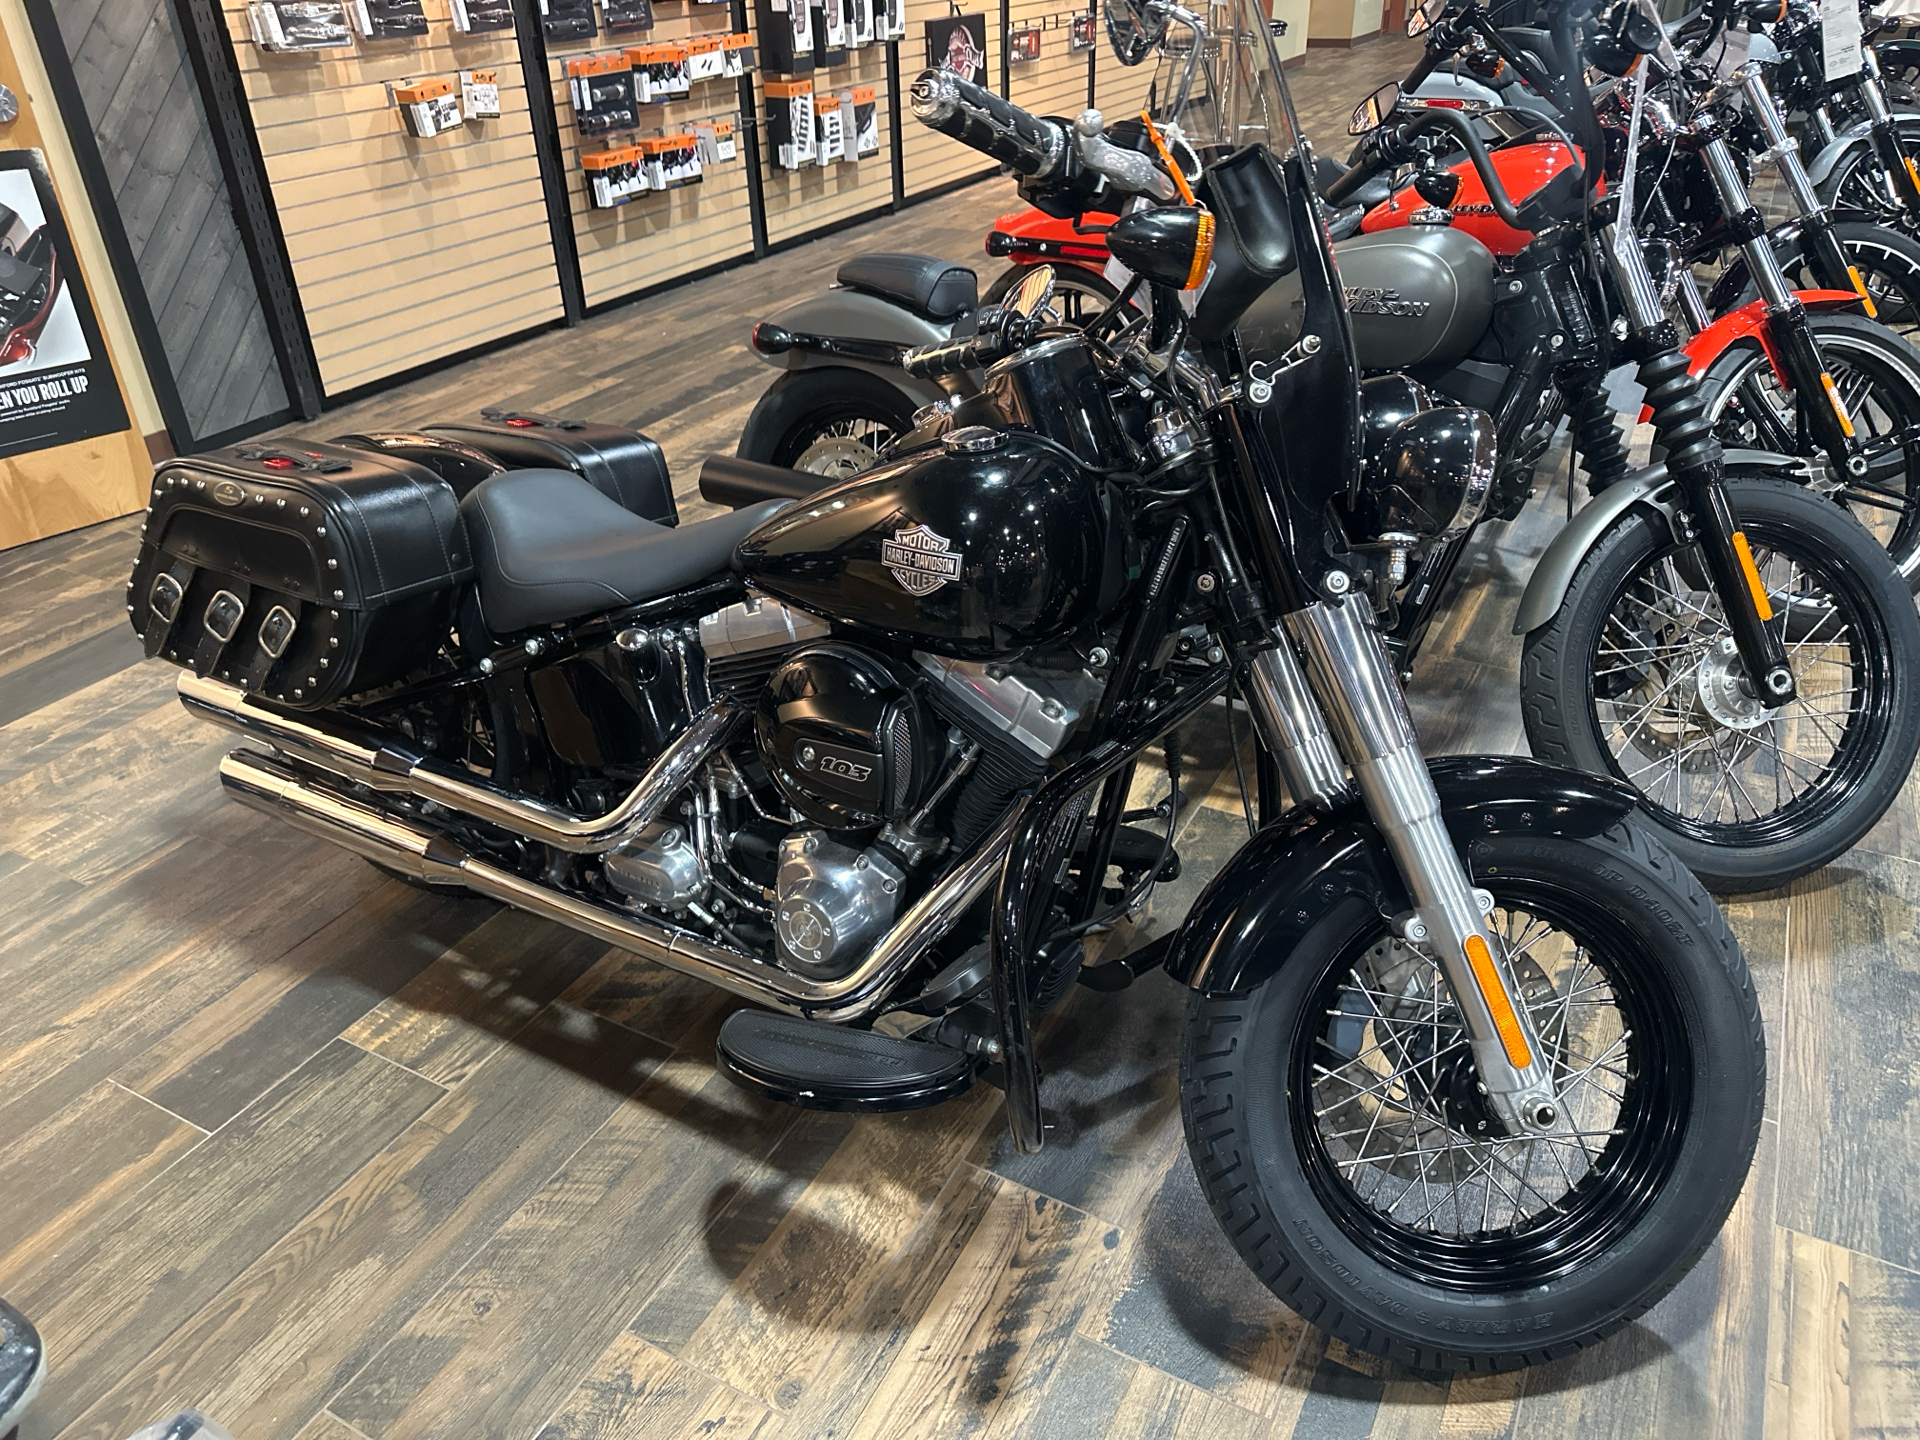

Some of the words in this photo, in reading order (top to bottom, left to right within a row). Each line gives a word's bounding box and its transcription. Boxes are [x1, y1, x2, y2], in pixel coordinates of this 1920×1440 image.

[11, 385, 40, 406] YOU
[38, 380, 73, 400] ROLL
[70, 375, 89, 394] UP
[902, 531, 938, 552] MOTOR
[886, 546, 955, 574] HARLEY-DAVIDSON
[900, 568, 936, 590] CYCLES
[820, 756, 872, 782] 103
[1513, 843, 1624, 883] DUNLOP
[1625, 884, 1696, 948] D402F
[1291, 1217, 1411, 1318] DAVIDSON
[1435, 1311, 1554, 1335] HARLEY
